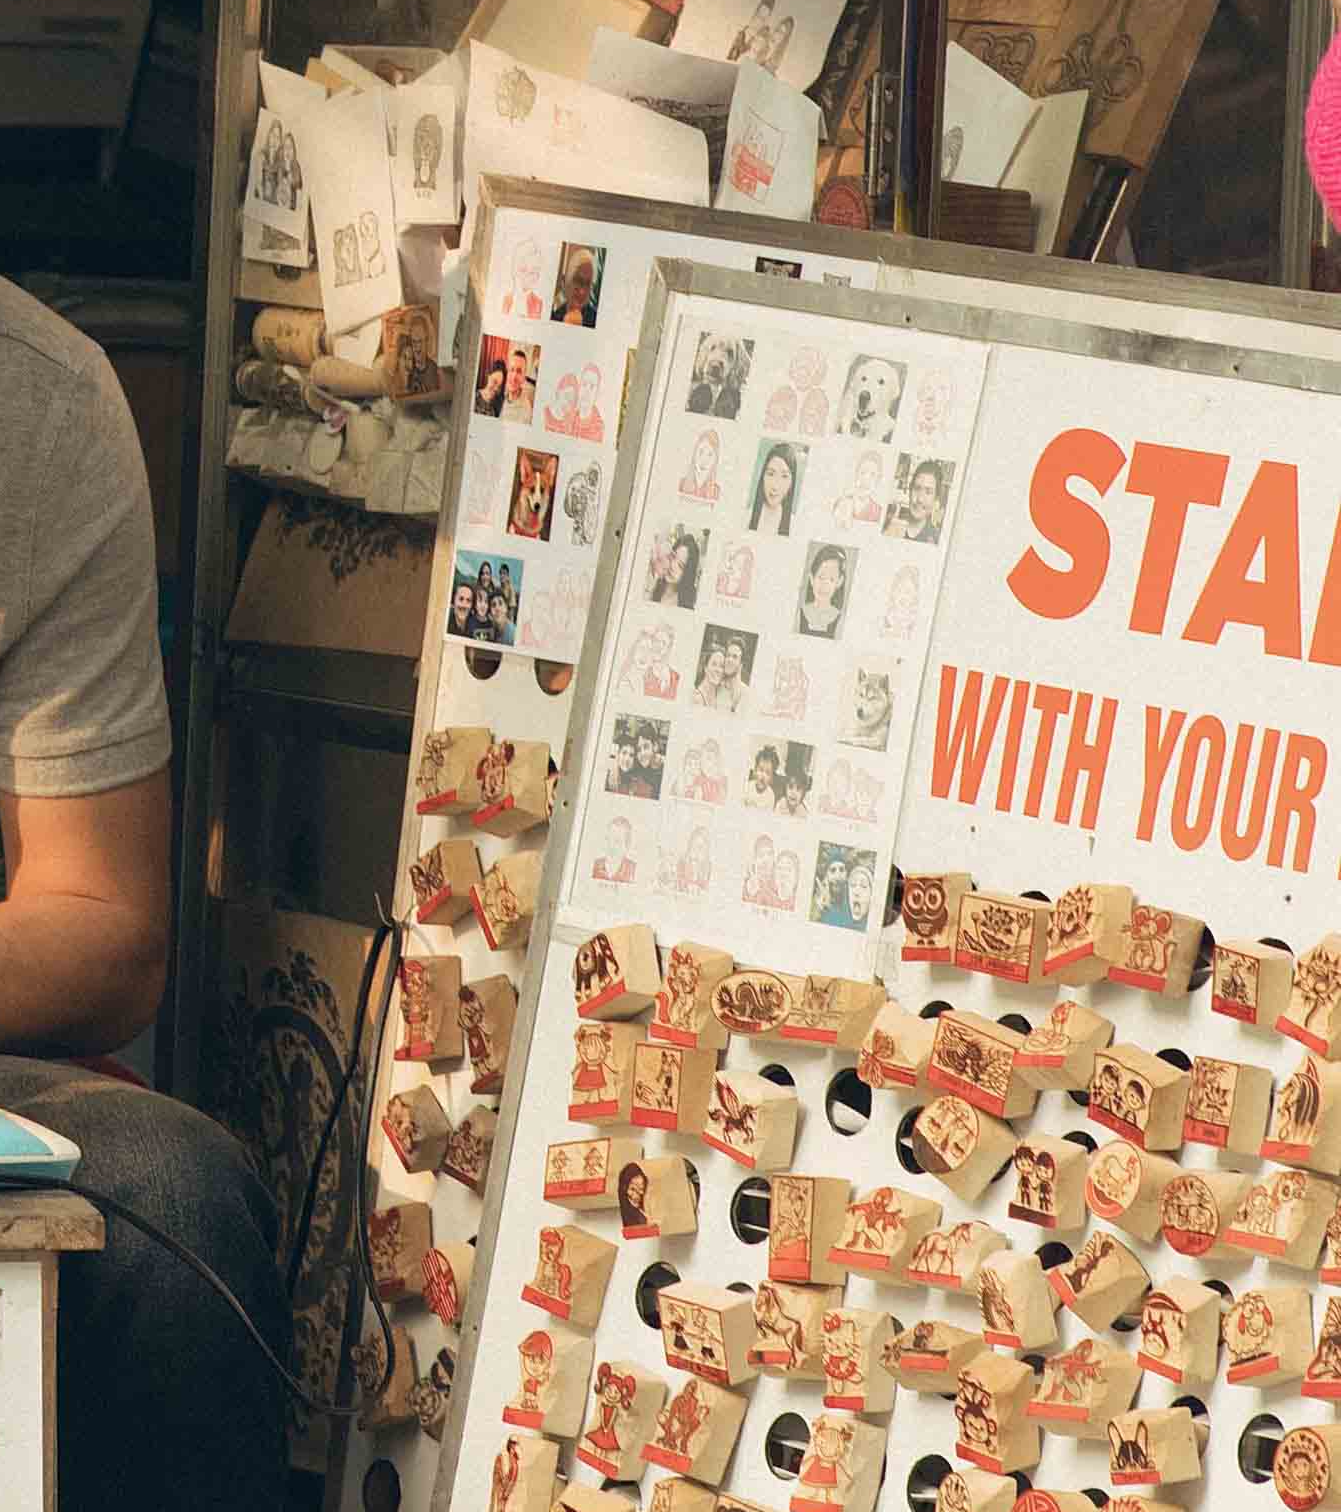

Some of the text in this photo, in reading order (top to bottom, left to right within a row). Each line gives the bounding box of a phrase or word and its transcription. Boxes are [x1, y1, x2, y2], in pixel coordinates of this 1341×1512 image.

[1005, 426, 1341, 668] STA
[930, 663, 1329, 874] WITH YOUR
